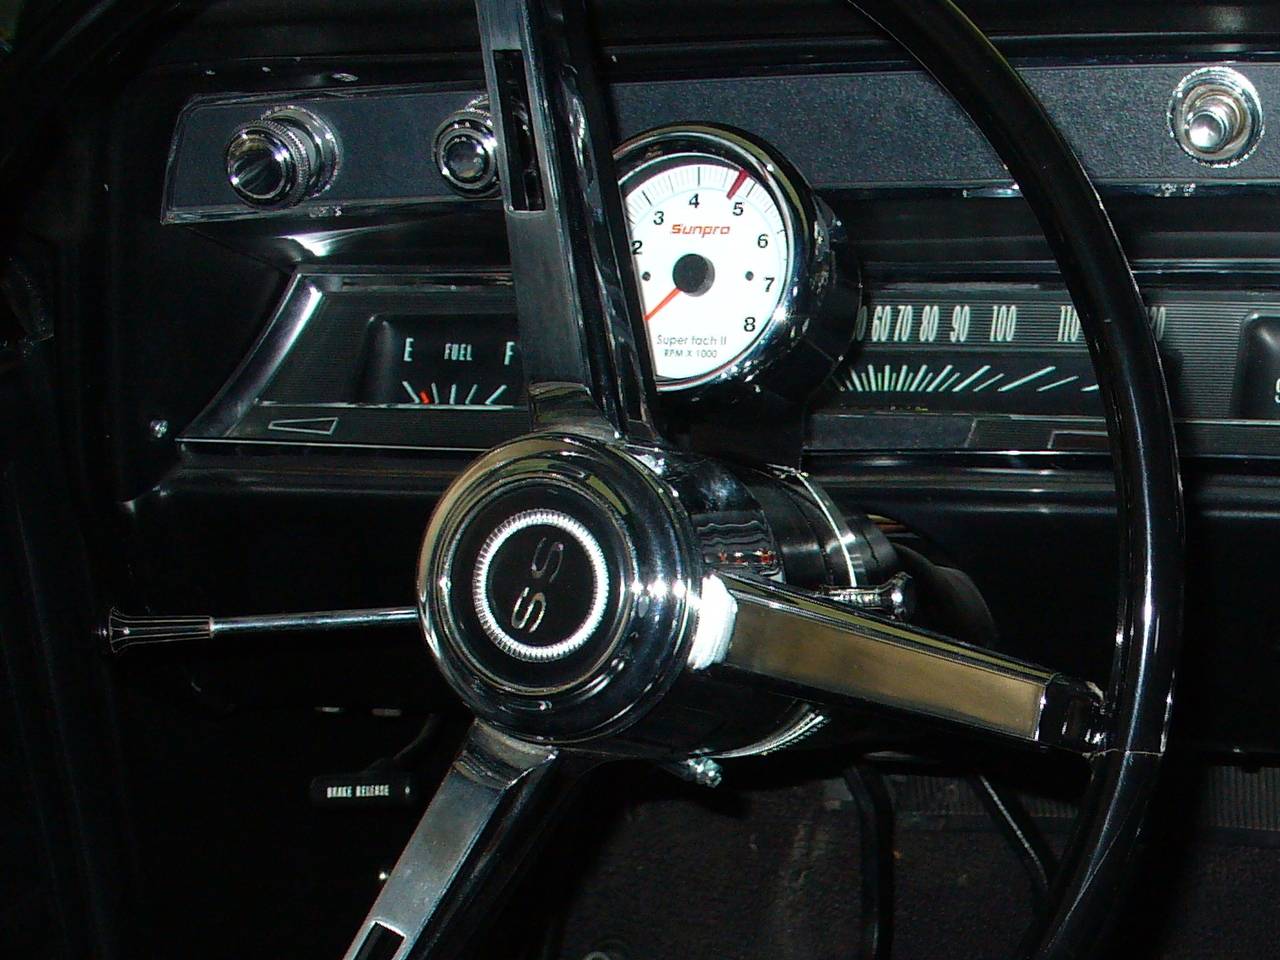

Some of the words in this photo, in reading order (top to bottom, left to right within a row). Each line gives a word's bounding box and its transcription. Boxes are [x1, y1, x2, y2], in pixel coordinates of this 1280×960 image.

[688, 193, 700, 209] 4
[733, 202, 744, 217] 5
[653, 211, 664, 226] 3
[671, 223, 731, 239] Sunpro
[631, 241, 643, 255] 2
[757, 234, 769, 249] 6
[764, 277, 775, 292] 7
[744, 317, 756, 332] 8
[871, 305, 891, 343] 60
[894, 305, 913, 343] 70
[919, 305, 939, 343] 80
[950, 305, 970, 343] 90
[989, 305, 1017, 343] 100
[1057, 305, 1081, 343] 110
[656, 334, 689, 347] Super
[403, 337, 414, 362] E
[444, 344, 472, 361] FUEL
[504, 341, 515, 365] F
[664, 349, 683, 358] RPM
[697, 349, 717, 358] 1000
